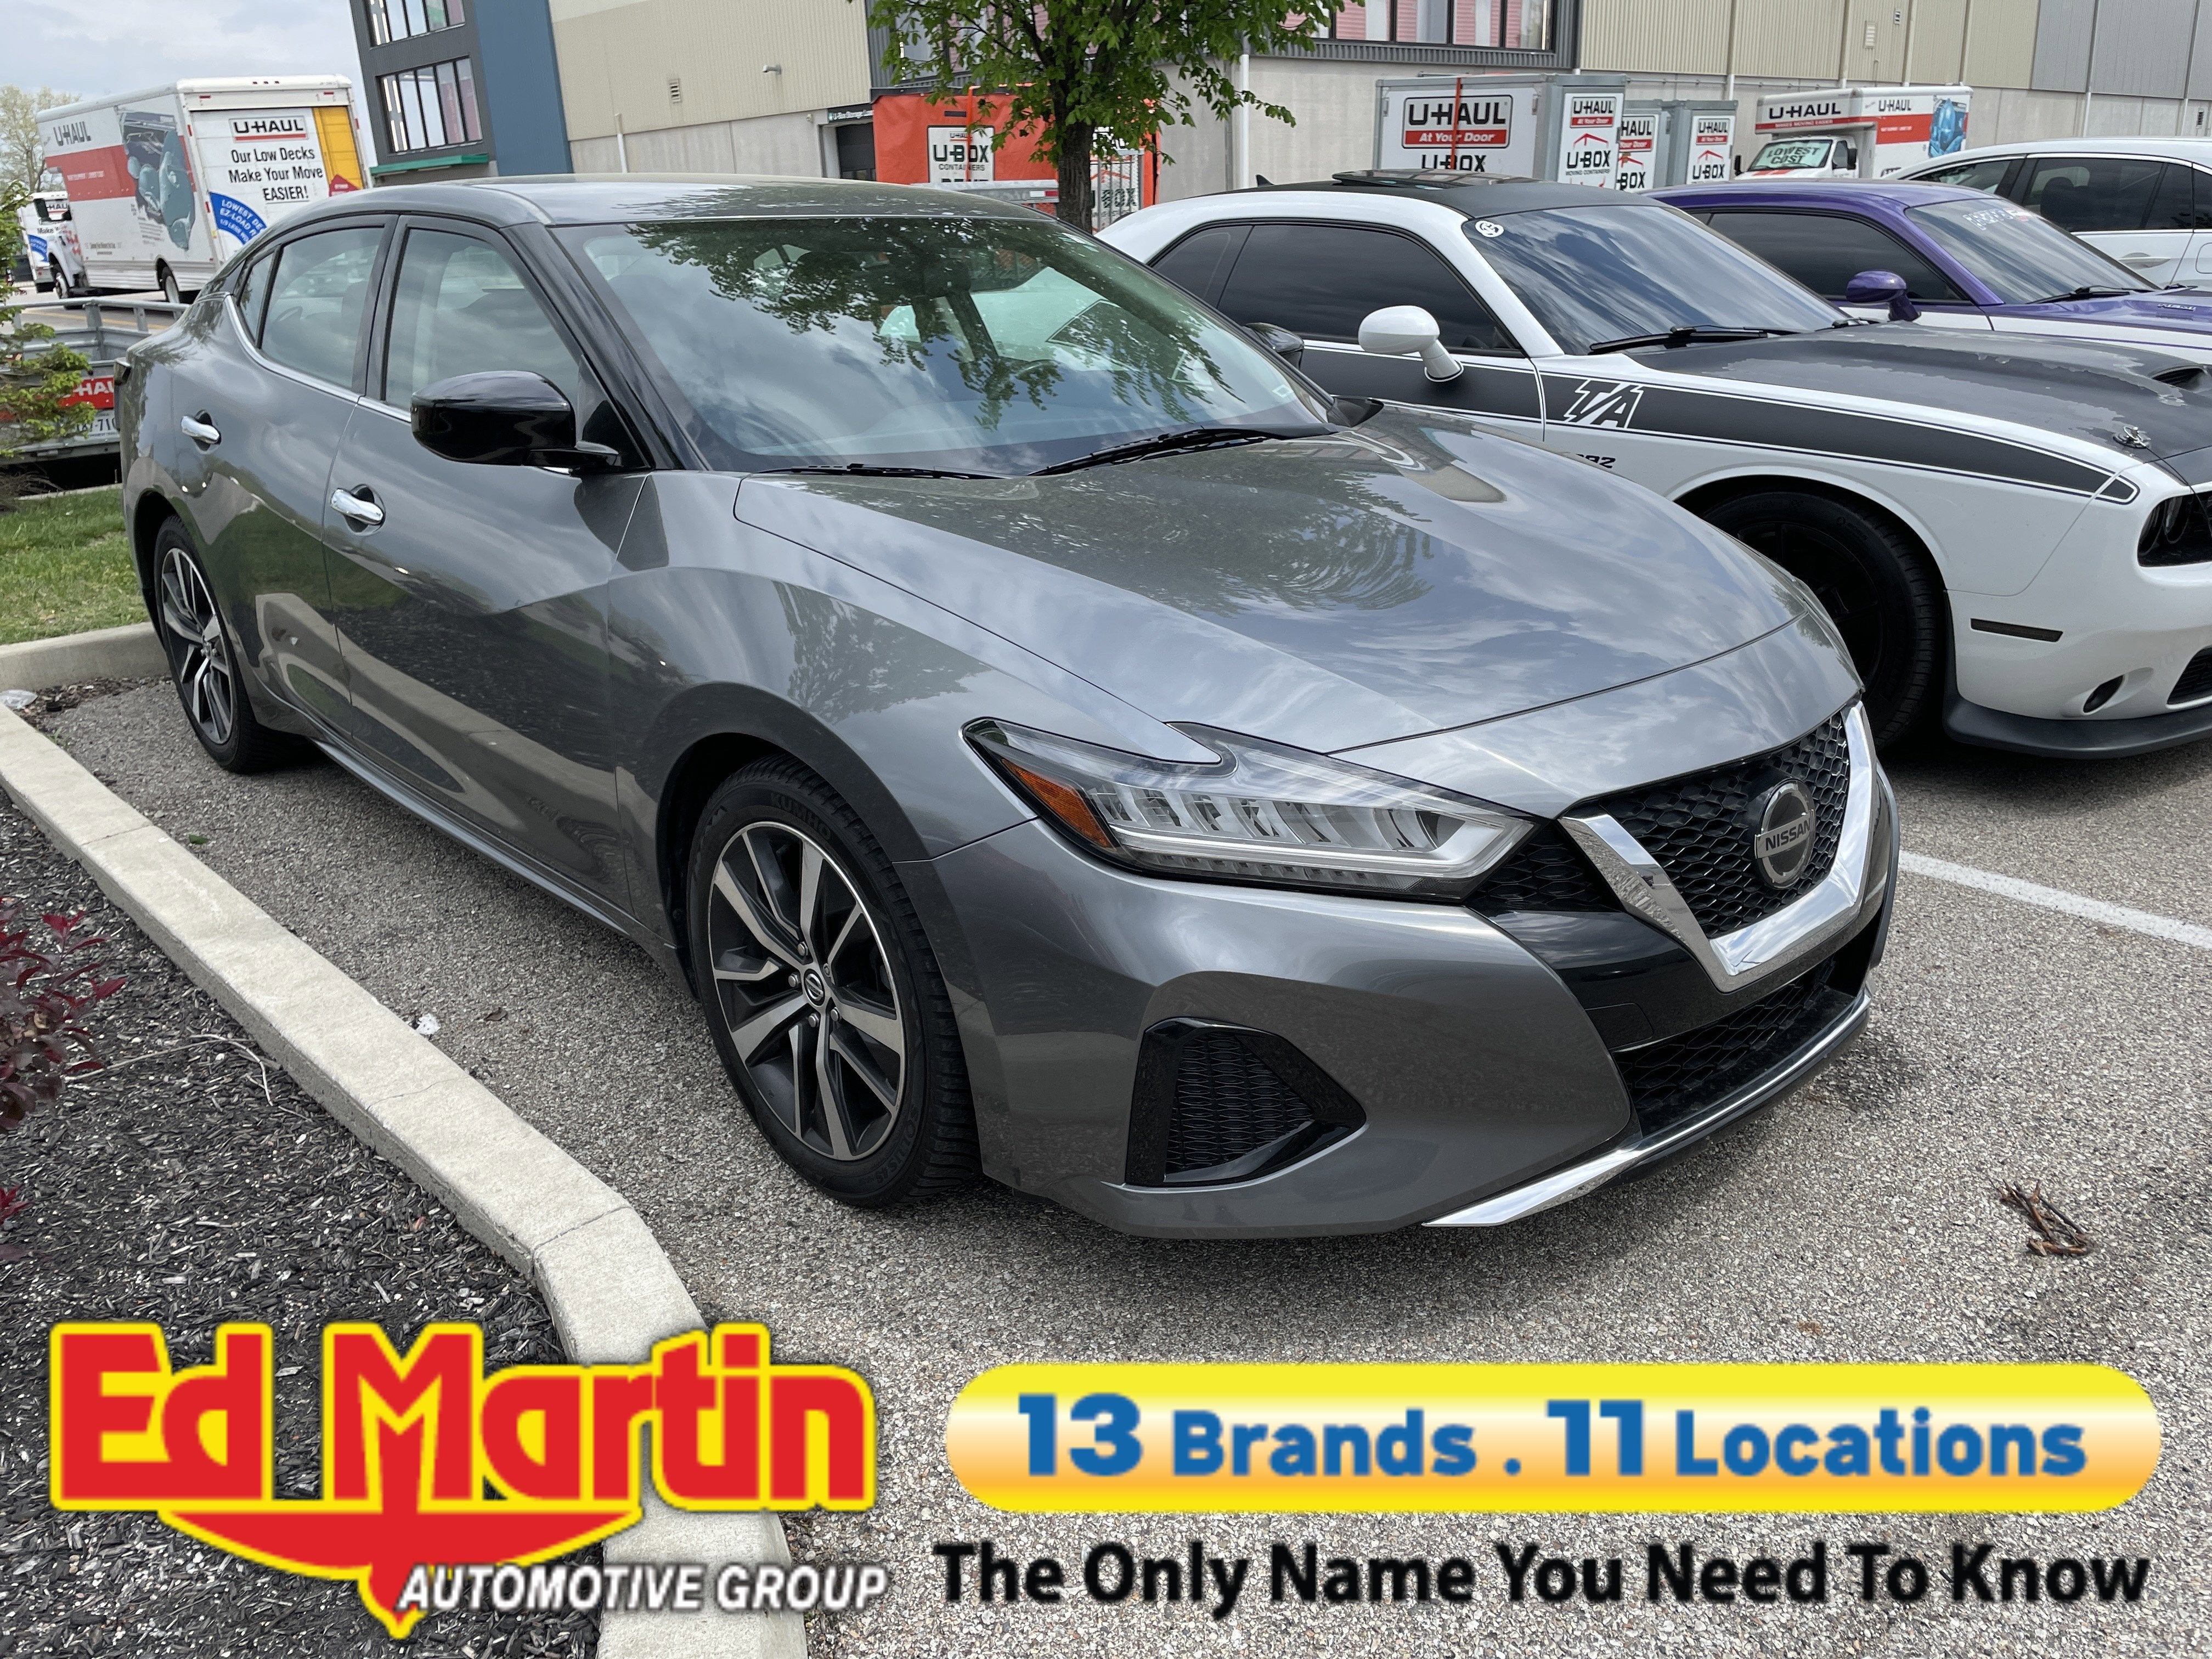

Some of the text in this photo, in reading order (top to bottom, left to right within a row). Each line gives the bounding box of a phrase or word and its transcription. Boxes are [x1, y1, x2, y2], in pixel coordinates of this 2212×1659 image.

[1573, 100, 1613, 114] U-HAUL
[1768, 102, 1842, 119] U-HAUL
[1878, 99, 1911, 111] U-HAUL
[1409, 102, 1506, 126] U-HAUL
[234, 114, 303, 133] U-HAUL
[1699, 122, 1728, 133] U-HAUL
[53, 121, 91, 146] U-HAUL
[1419, 133, 1433, 142] At
[1464, 132, 1496, 142] Door
[231, 146, 315, 163] Our Low Decks
[933, 144, 989, 162] U-BOX
[1567, 150, 1611, 169] U-BOX
[1767, 146, 1820, 159] LOWEST
[1770, 155, 1804, 165] COST
[1421, 154, 1487, 172] U-BOX
[1692, 163, 1725, 179] U-BOX
[228, 165, 323, 183] Make Your Move
[263, 185, 309, 201] EASIER!
[221, 199, 253, 220] LOWEST
[1576, 453, 1616, 469] 92
[771, 792, 831, 840] KUMHO
[1765, 819, 1810, 851] NISSAN
